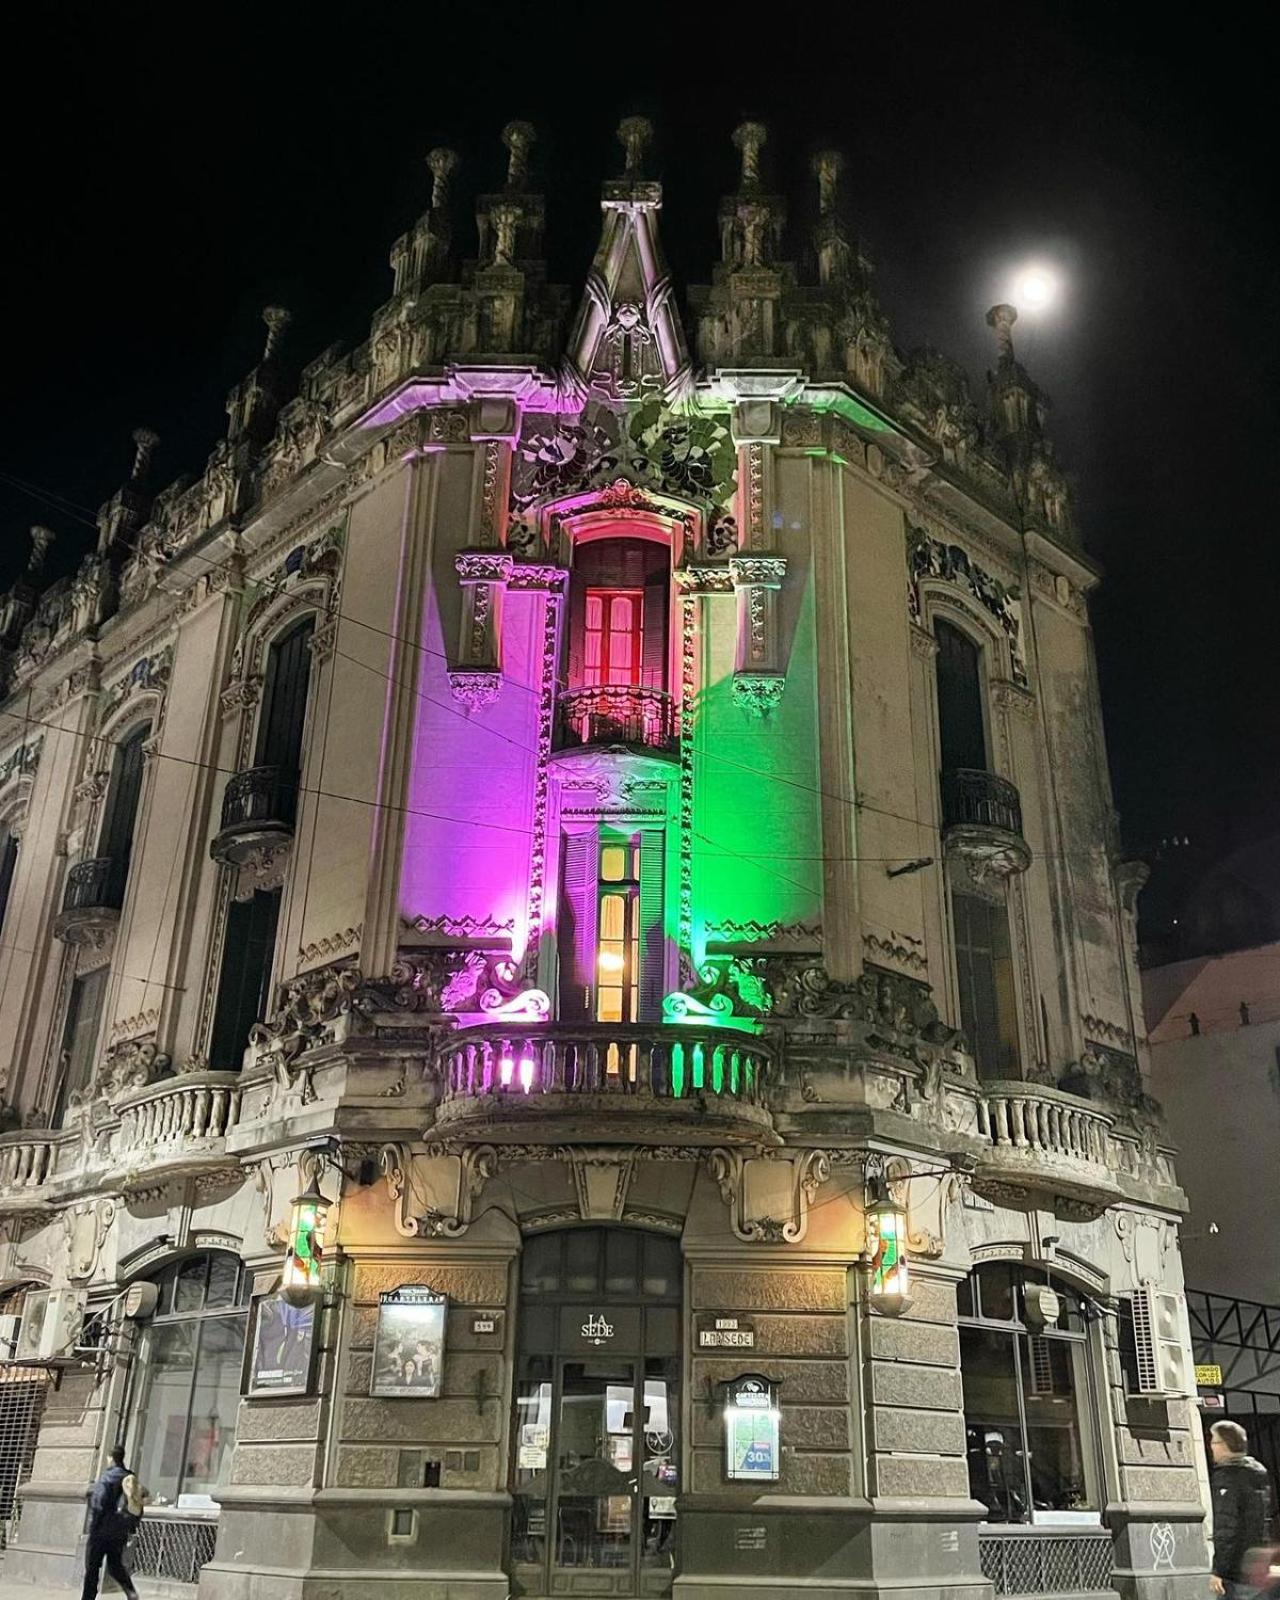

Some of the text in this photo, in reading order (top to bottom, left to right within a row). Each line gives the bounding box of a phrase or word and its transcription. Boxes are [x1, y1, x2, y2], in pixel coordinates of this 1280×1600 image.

[588, 1314, 608, 1326] LA
[581, 1324, 614, 1337] SEDE
[724, 1333, 750, 1345] SEDE
